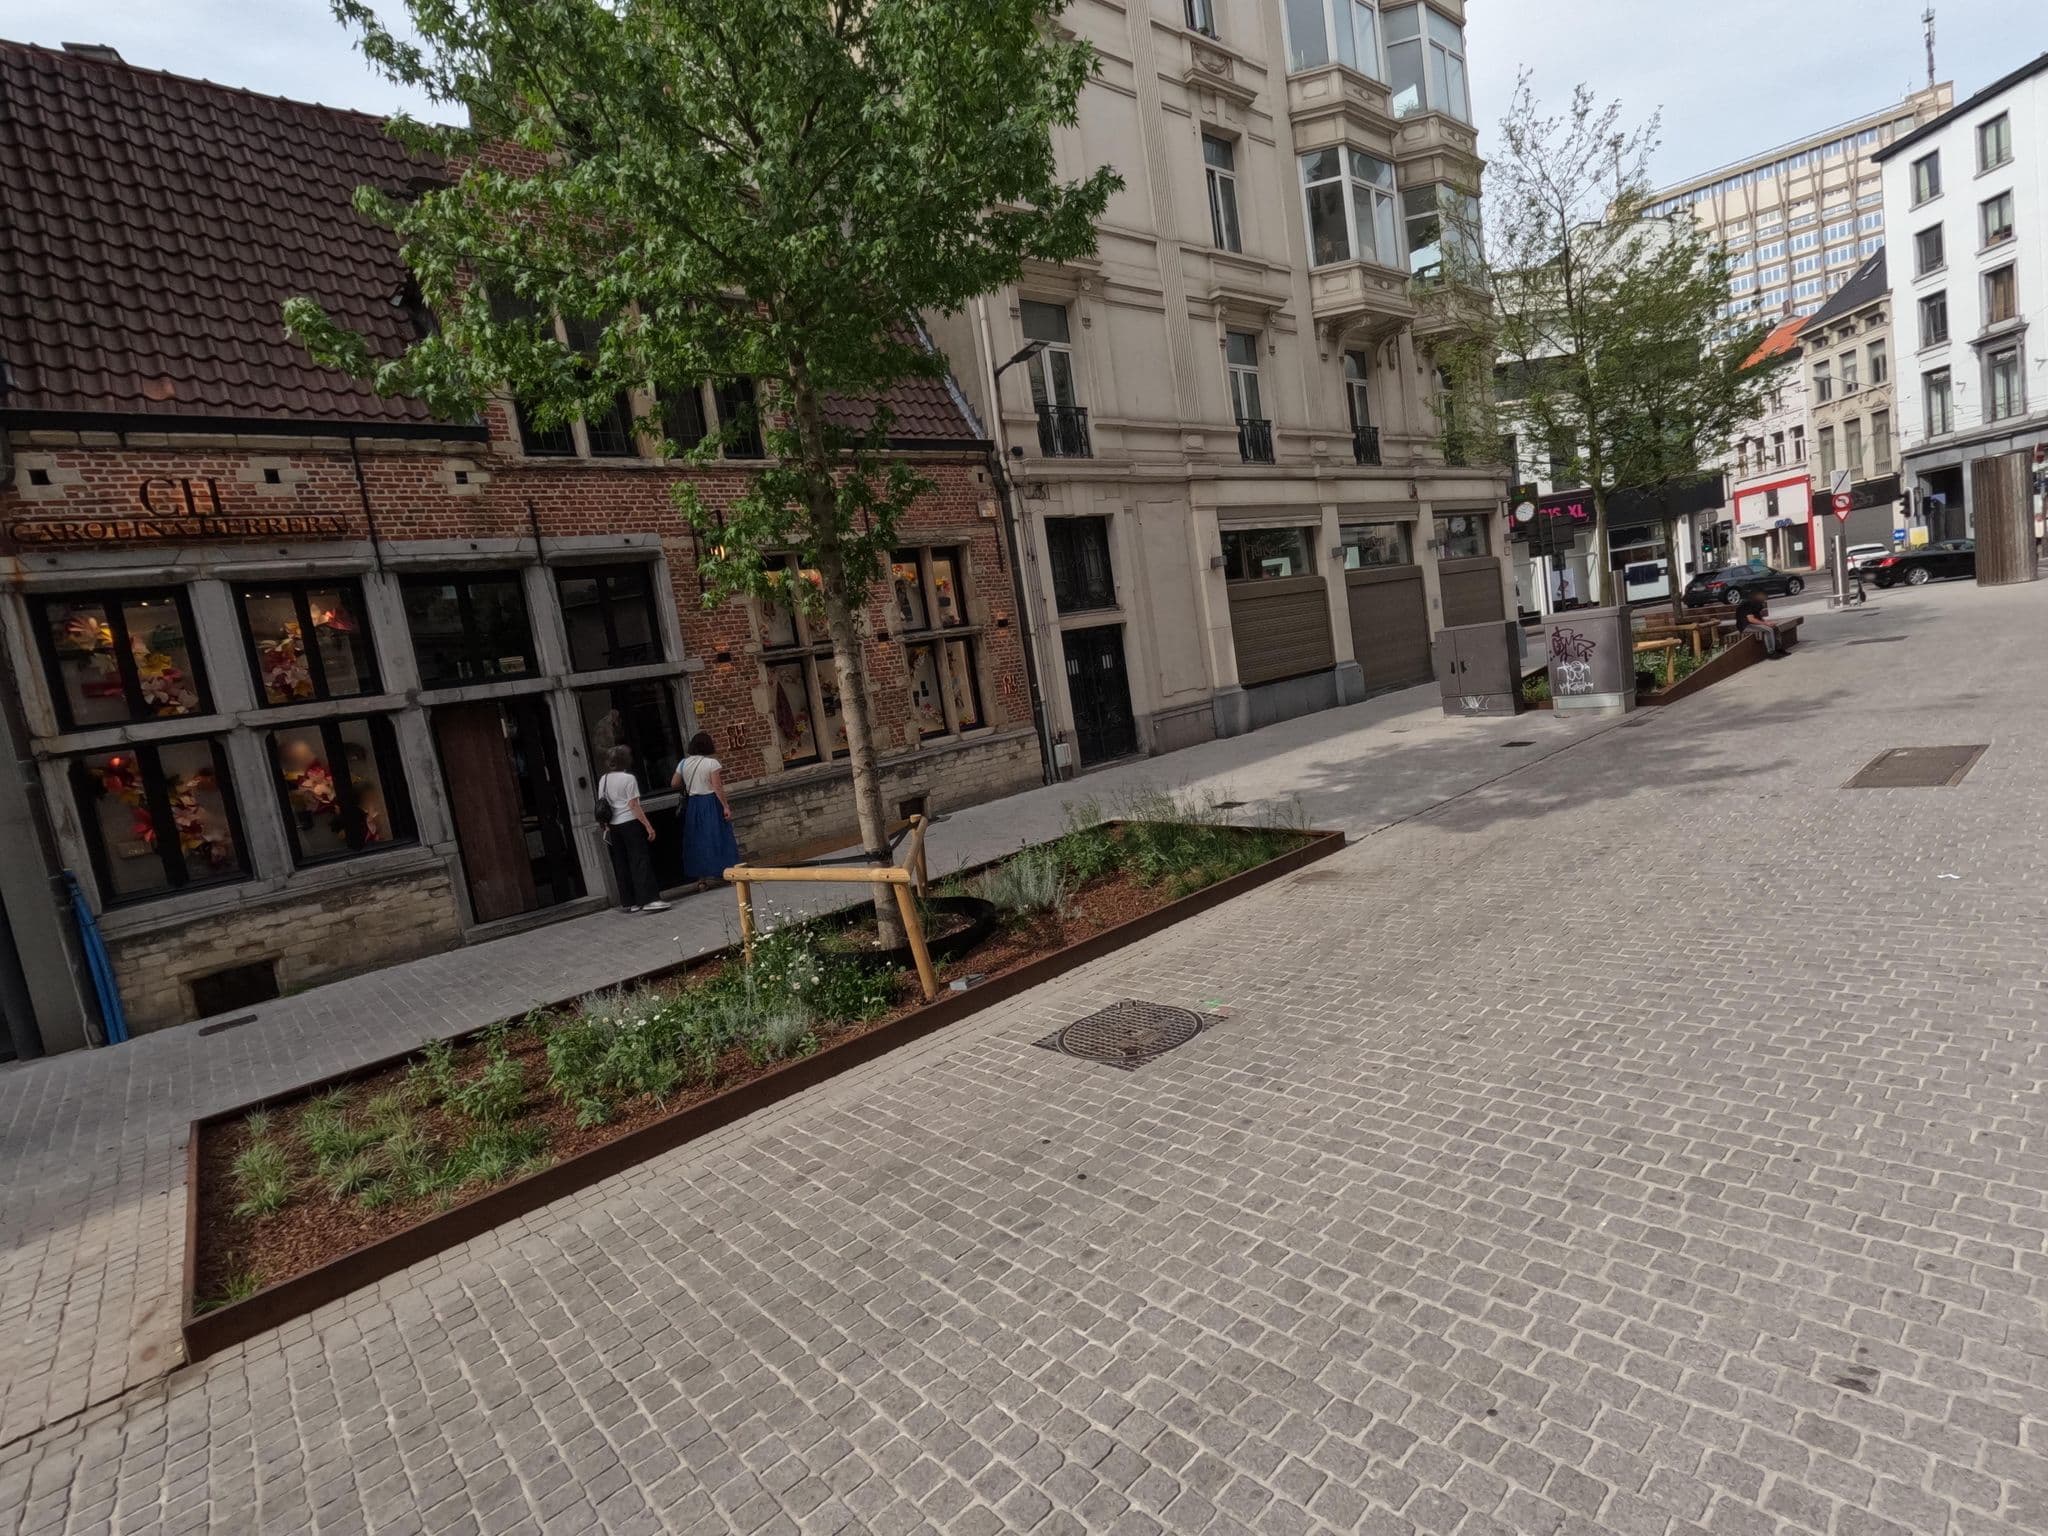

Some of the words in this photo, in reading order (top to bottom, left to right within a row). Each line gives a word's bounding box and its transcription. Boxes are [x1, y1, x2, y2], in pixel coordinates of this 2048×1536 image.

[139, 476, 228, 519] CH
[8, 517, 194, 545] CAROLINA
[198, 513, 347, 541] HERRERA
